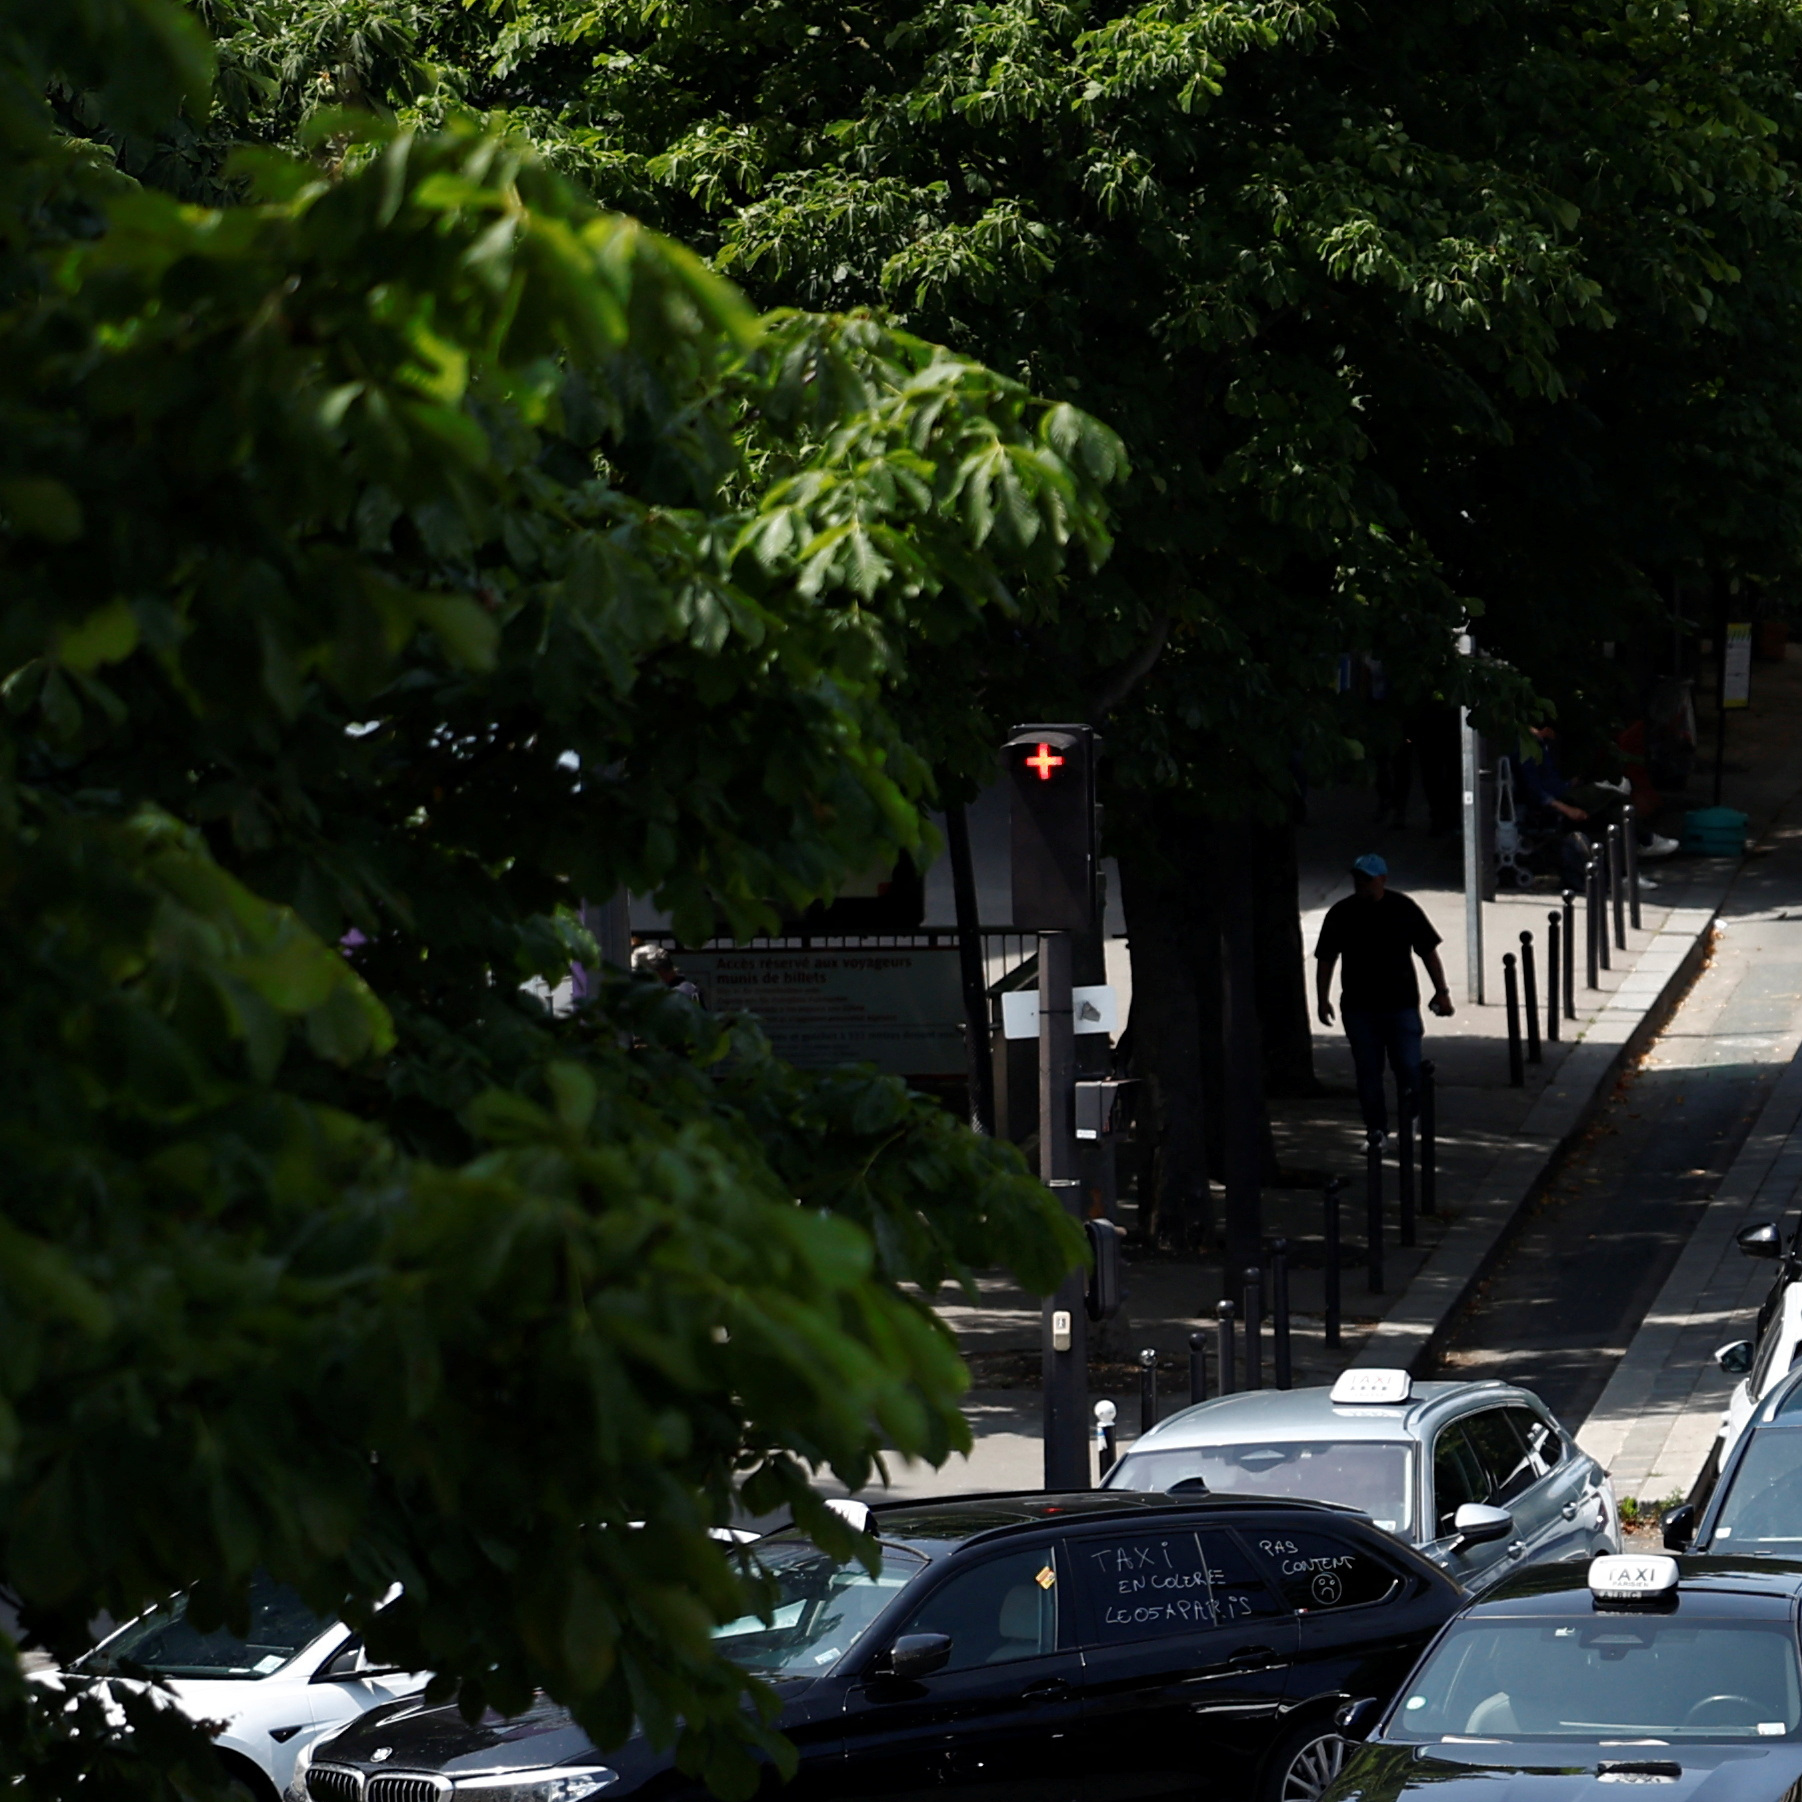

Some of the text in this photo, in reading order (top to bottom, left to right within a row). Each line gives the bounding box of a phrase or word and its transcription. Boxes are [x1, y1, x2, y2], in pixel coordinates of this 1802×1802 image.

[717, 956, 912, 974] Accès réservé aux voyageurs
[717, 971, 827, 985] munis de billets
[1350, 1375, 1392, 1384] TAXI
[1260, 1540, 1298, 1557] PAS
[1282, 1556, 1356, 1575] CONTENT
[1609, 1567, 1654, 1581] TAXI
